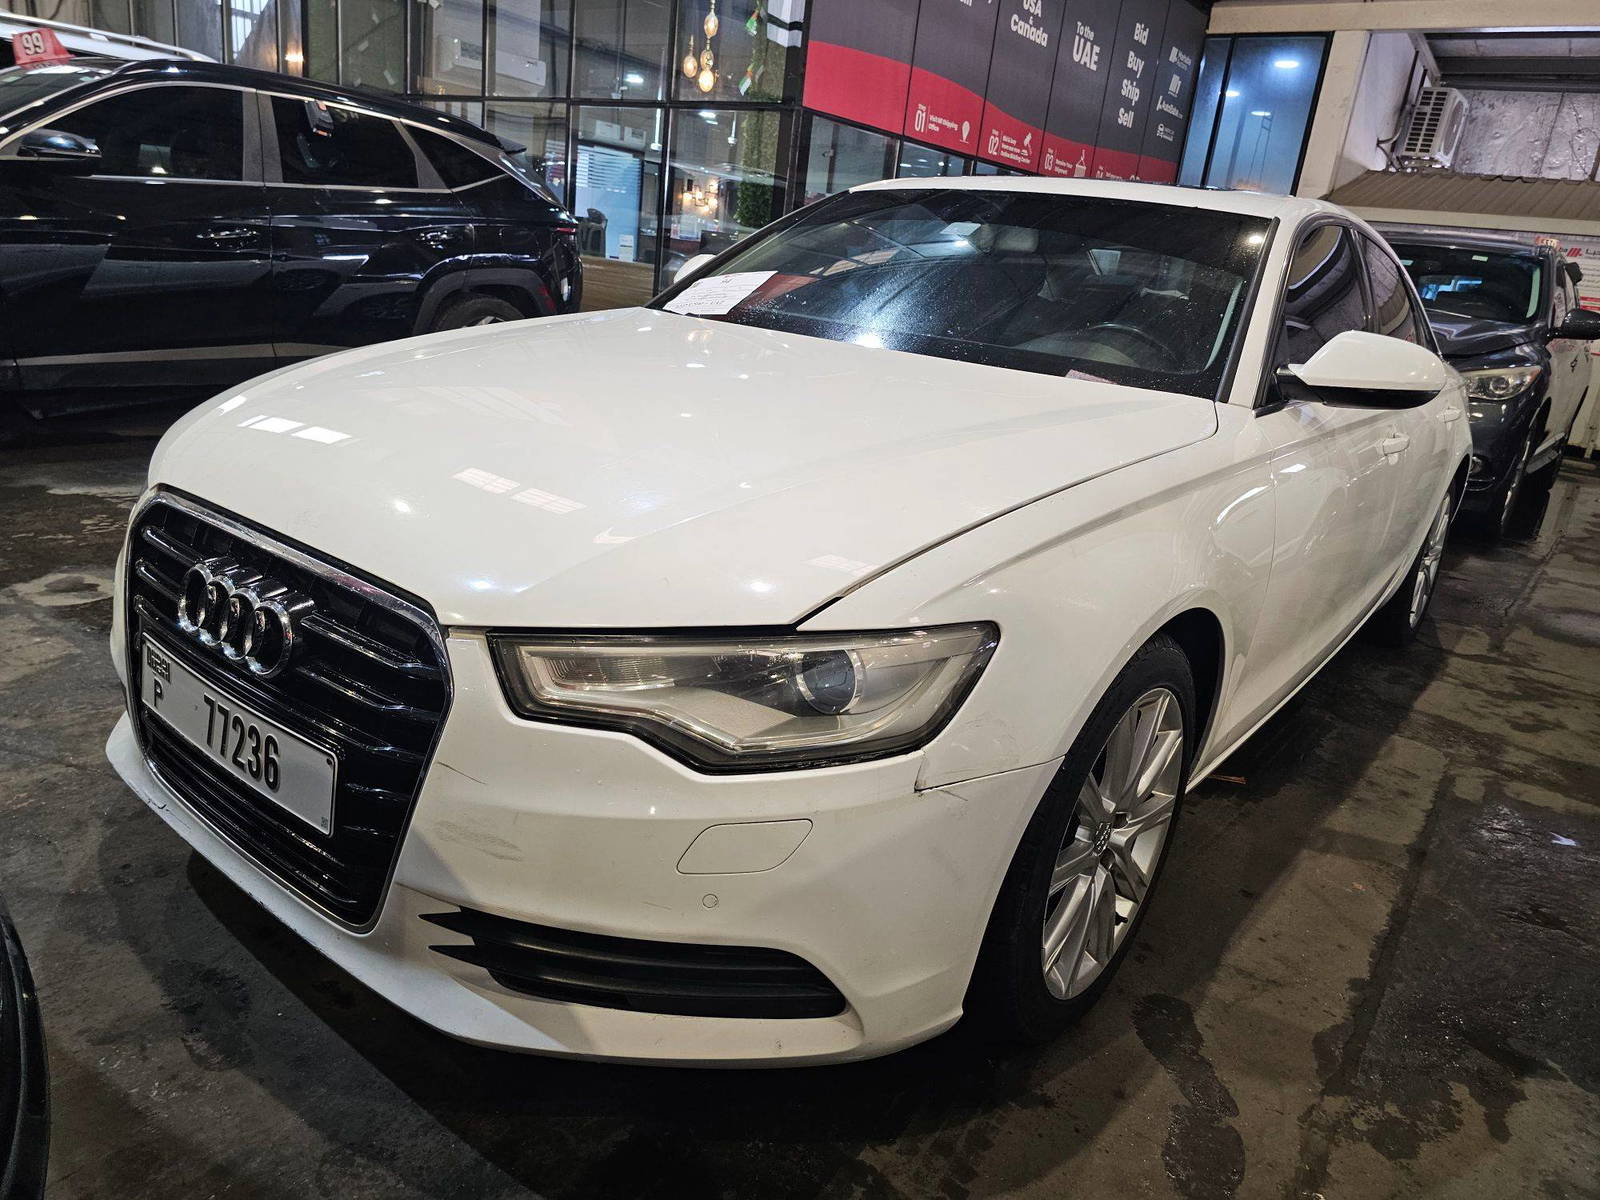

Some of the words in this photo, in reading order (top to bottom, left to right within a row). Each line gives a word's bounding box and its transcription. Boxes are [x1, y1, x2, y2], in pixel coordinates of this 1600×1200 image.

[1023, 0, 1041, 17] USA
[1010, 14, 1048, 47] Canada
[1076, 21, 1084, 35] To
[1084, 25, 1094, 41] the
[1133, 22, 1149, 46] Bid
[22, 32, 45, 55] 99
[1072, 35, 1101, 71] UAE
[1127, 50, 1144, 79] Buy
[1121, 78, 1140, 106] Ship
[914, 110, 926, 132] 01
[1117, 107, 1134, 128] Sell
[988, 136, 999, 155] 02
[1045, 154, 1054, 170] 03
[153, 678, 163, 707] P
[203, 693, 280, 790] 77236
